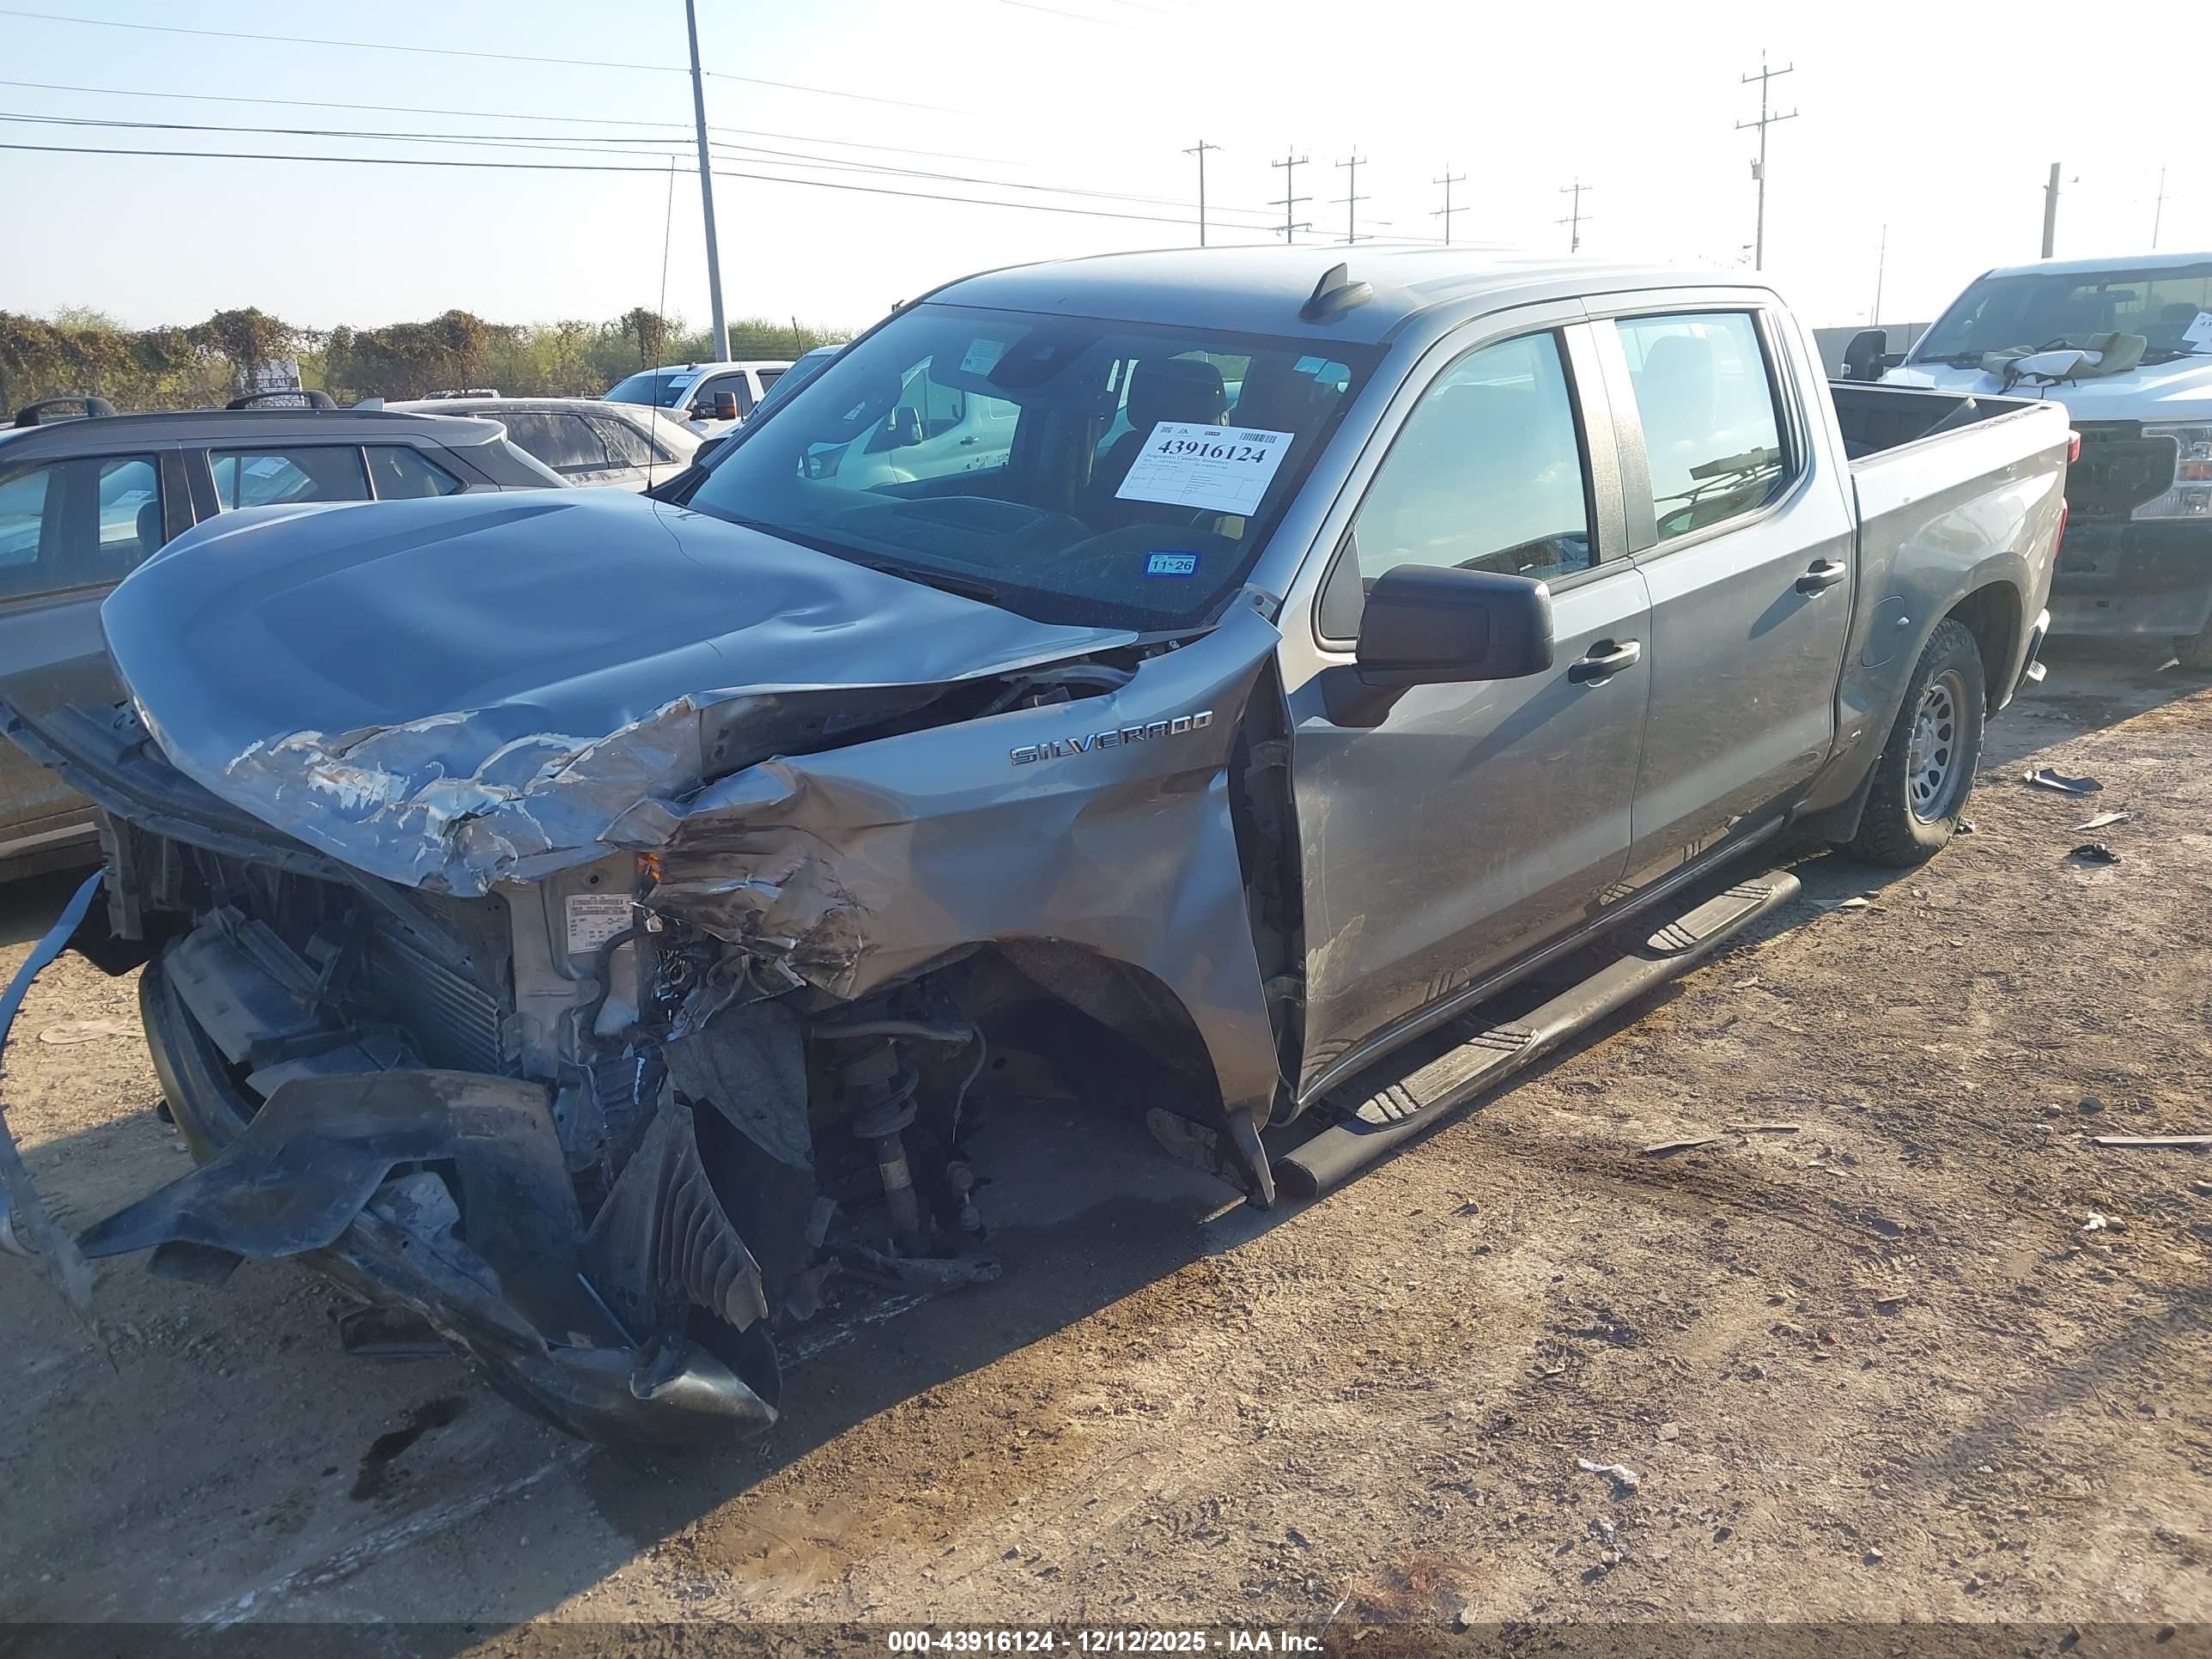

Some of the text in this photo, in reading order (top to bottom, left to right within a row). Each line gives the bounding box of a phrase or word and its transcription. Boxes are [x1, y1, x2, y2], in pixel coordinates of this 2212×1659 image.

[1158, 439, 1267, 464] 43916124
[1177, 454, 1200, 465] Casualty
[1152, 560, 1193, 570] 11 26
[1010, 709, 1213, 766] SILVERADO
